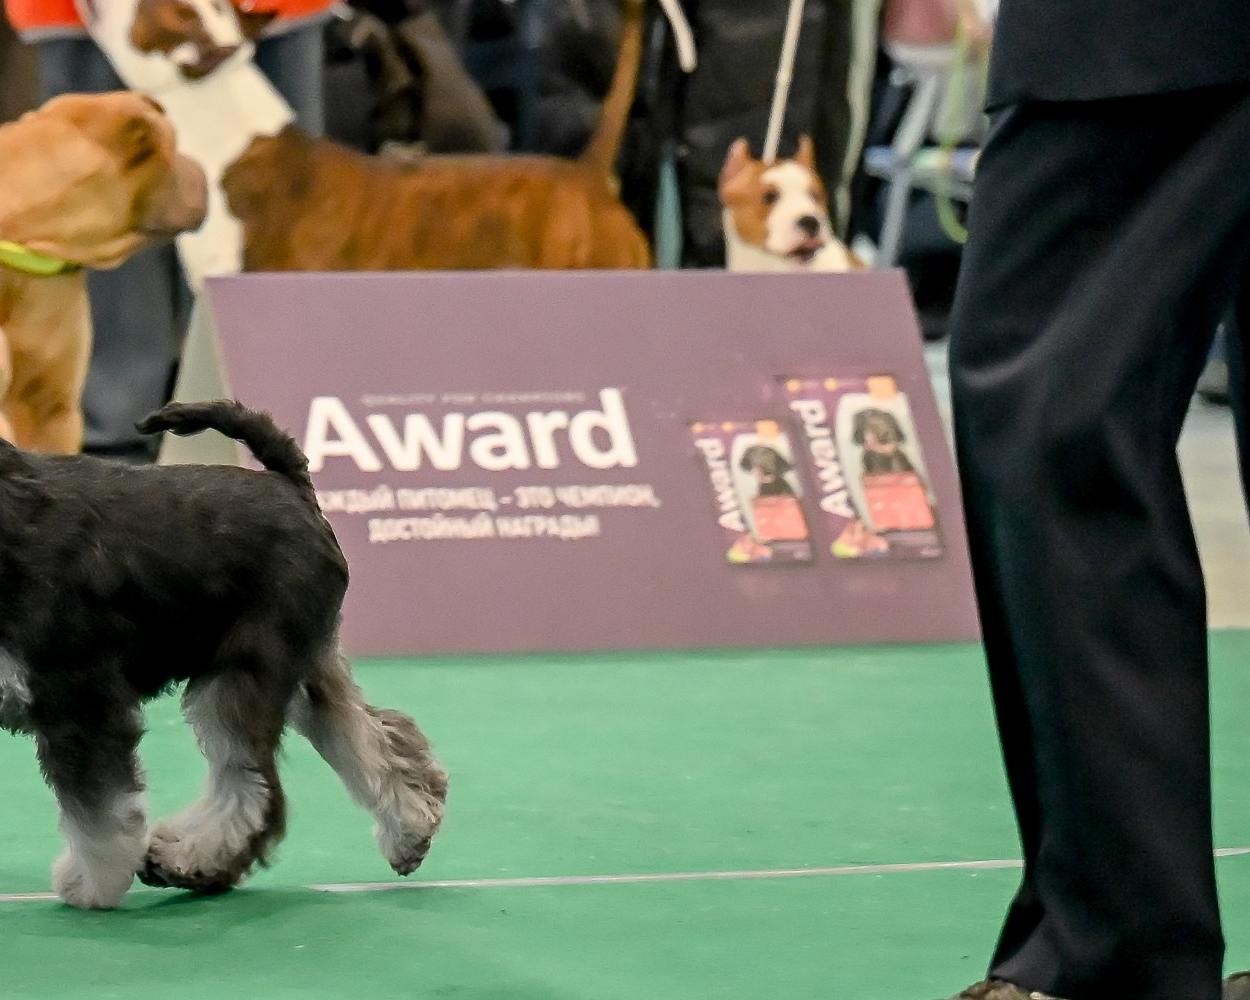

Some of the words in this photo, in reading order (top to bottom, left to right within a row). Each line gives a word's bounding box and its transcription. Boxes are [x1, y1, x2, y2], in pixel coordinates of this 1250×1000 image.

[304, 386, 638, 472] Award
[789, 400, 856, 518] Award
[367, 512, 495, 543] ДОСТОЙНЫЙ
[513, 485, 556, 509] ЭТО
[694, 438, 747, 532] Award
